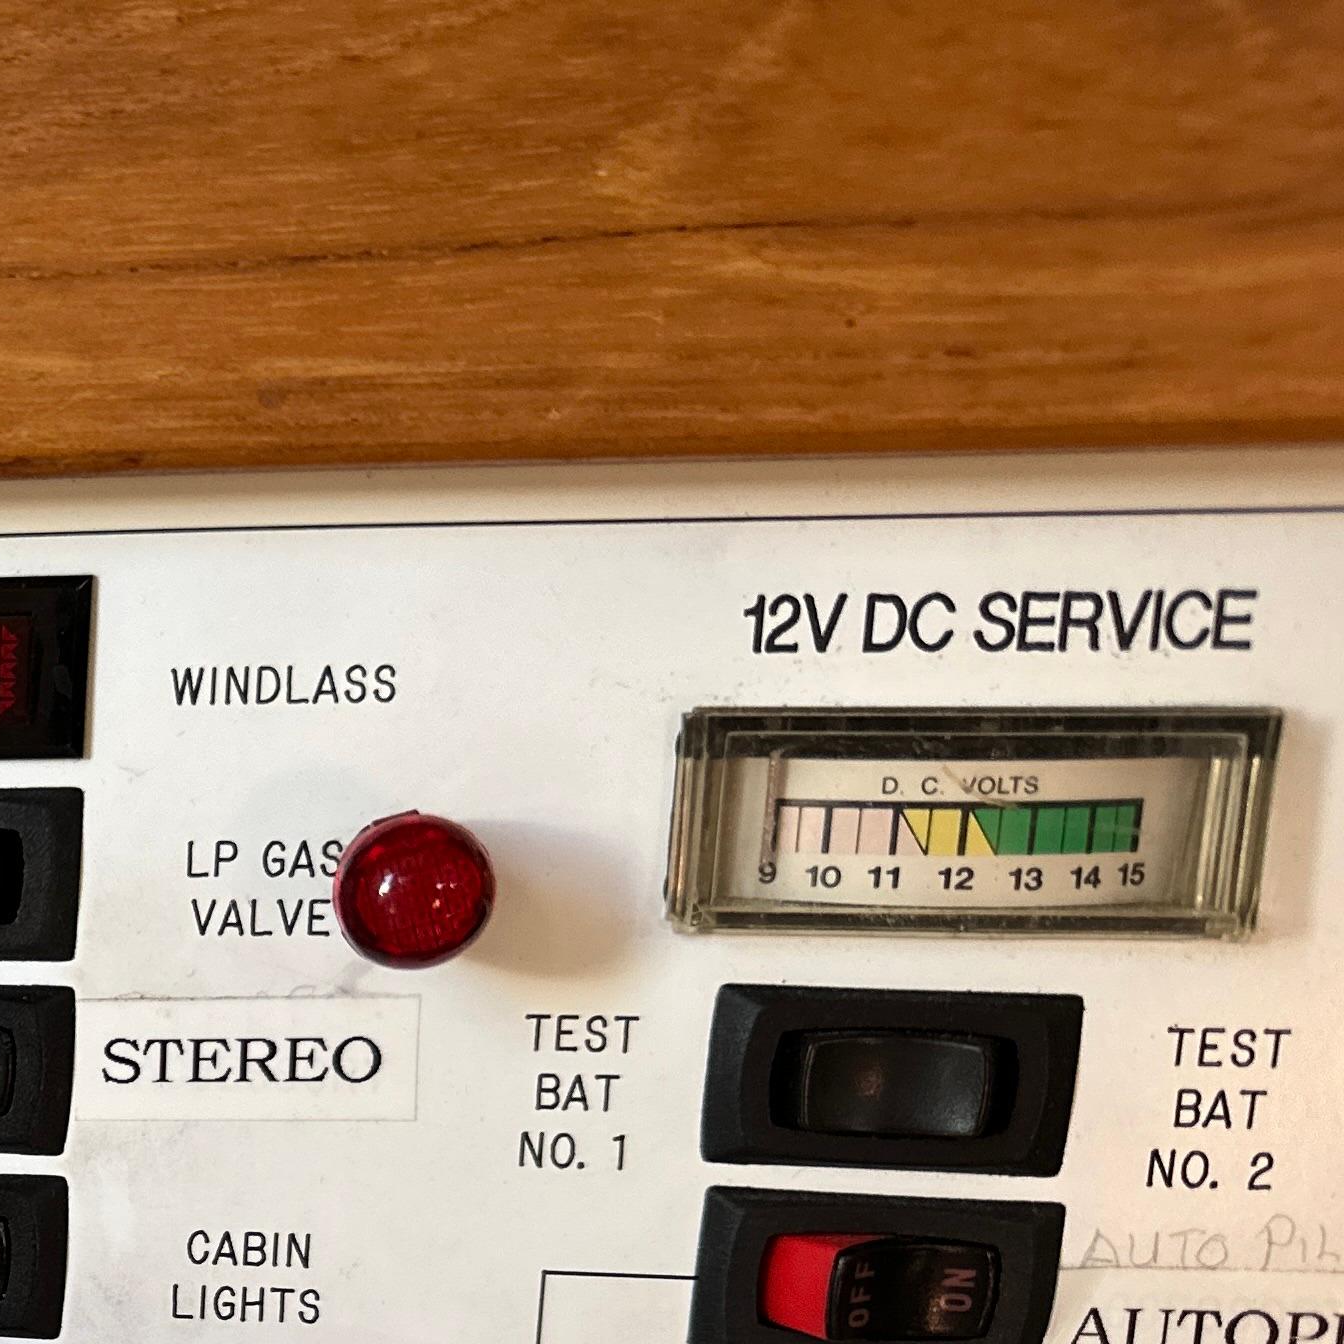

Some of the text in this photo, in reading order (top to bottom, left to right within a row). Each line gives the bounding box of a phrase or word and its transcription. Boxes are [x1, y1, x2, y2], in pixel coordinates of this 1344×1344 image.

[743, 588, 1260, 653] 12V DC SERVICE
[172, 664, 398, 705] WINDLASS
[962, 776, 1039, 795] VOLTS
[186, 840, 344, 878] LP GAS
[758, 861, 1145, 891] 9 10 11 12 13 14 15
[191, 898, 331, 937] VALVE
[526, 1014, 640, 1055] TEST
[1168, 1027, 1292, 1069] TEST
[101, 1035, 384, 1086] STEREO
[535, 1073, 621, 1113] BAT
[1173, 1090, 1268, 1131] BAT
[518, 1131, 628, 1171] NO. 1
[1146, 1148, 1276, 1193] NO. 2
[186, 1230, 312, 1269] CABIN
[172, 1286, 321, 1324] LIGHTS
[848, 1260, 976, 1328] OFF ON
